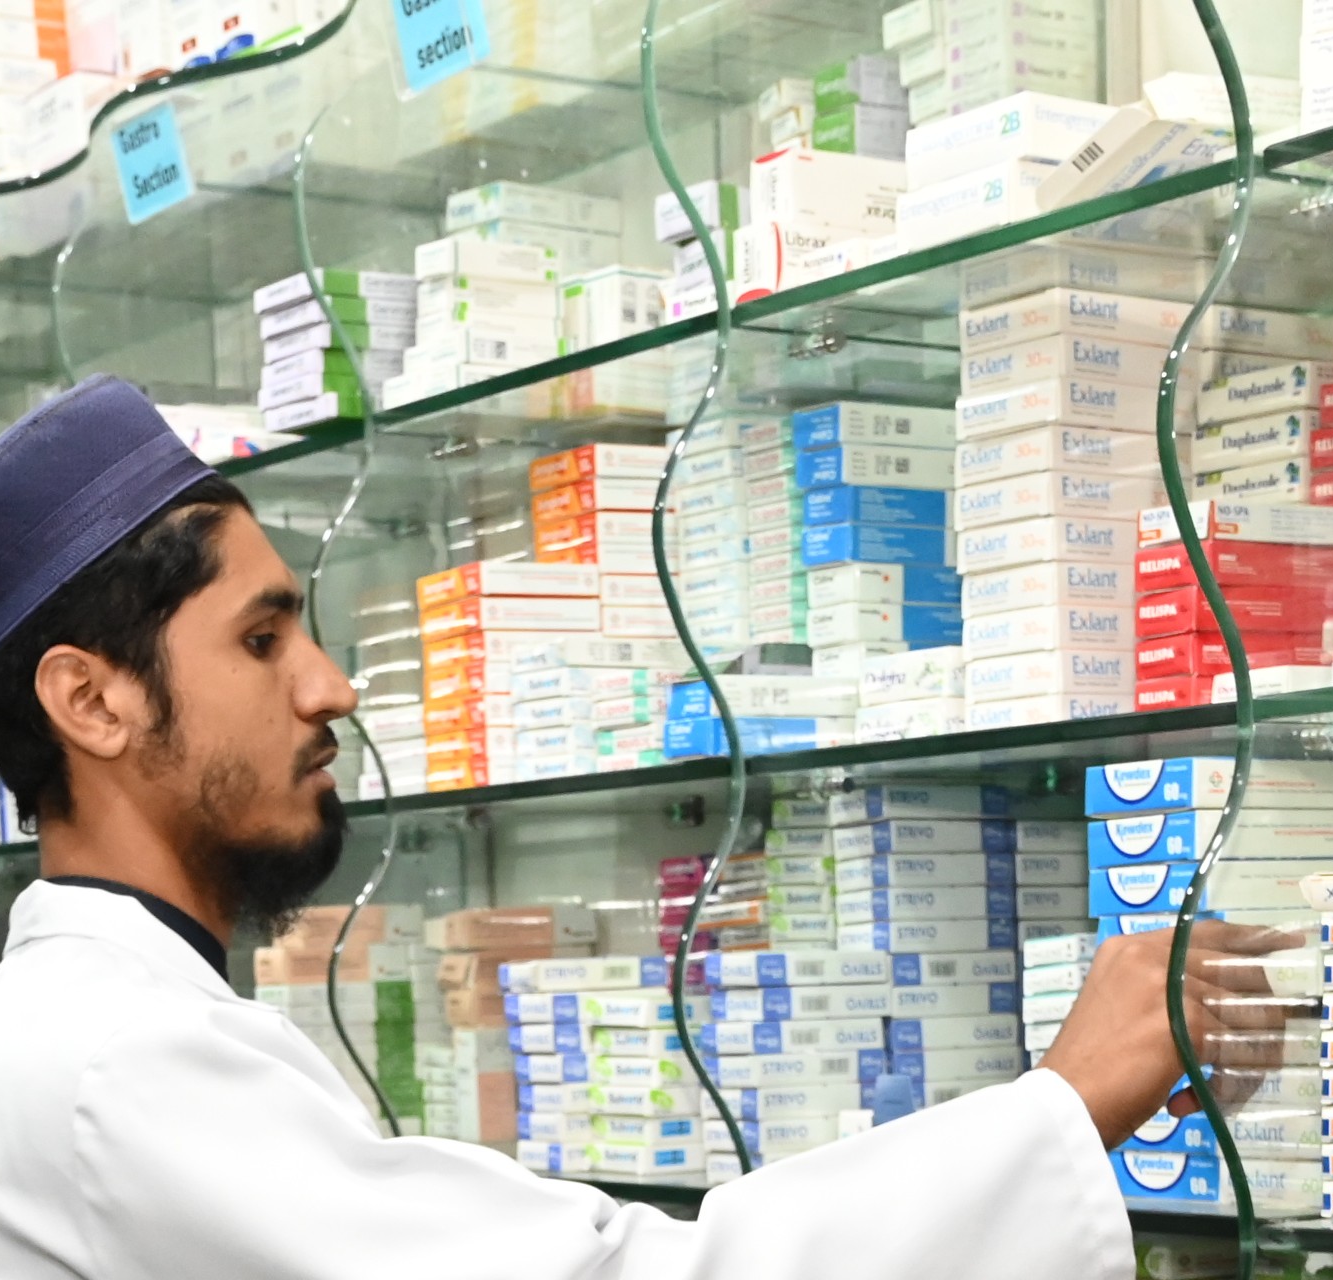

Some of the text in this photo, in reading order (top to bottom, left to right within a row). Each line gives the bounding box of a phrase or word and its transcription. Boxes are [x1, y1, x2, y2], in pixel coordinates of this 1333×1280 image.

[417, 25, 474, 69] section
[134, 162, 180, 198] Section
[1069, 295, 1118, 322] Exlant
[1066, 524, 1113, 545] Exlant
[1139, 557, 1181, 574] RELISPA
[1073, 650, 1120, 675] Exlant
